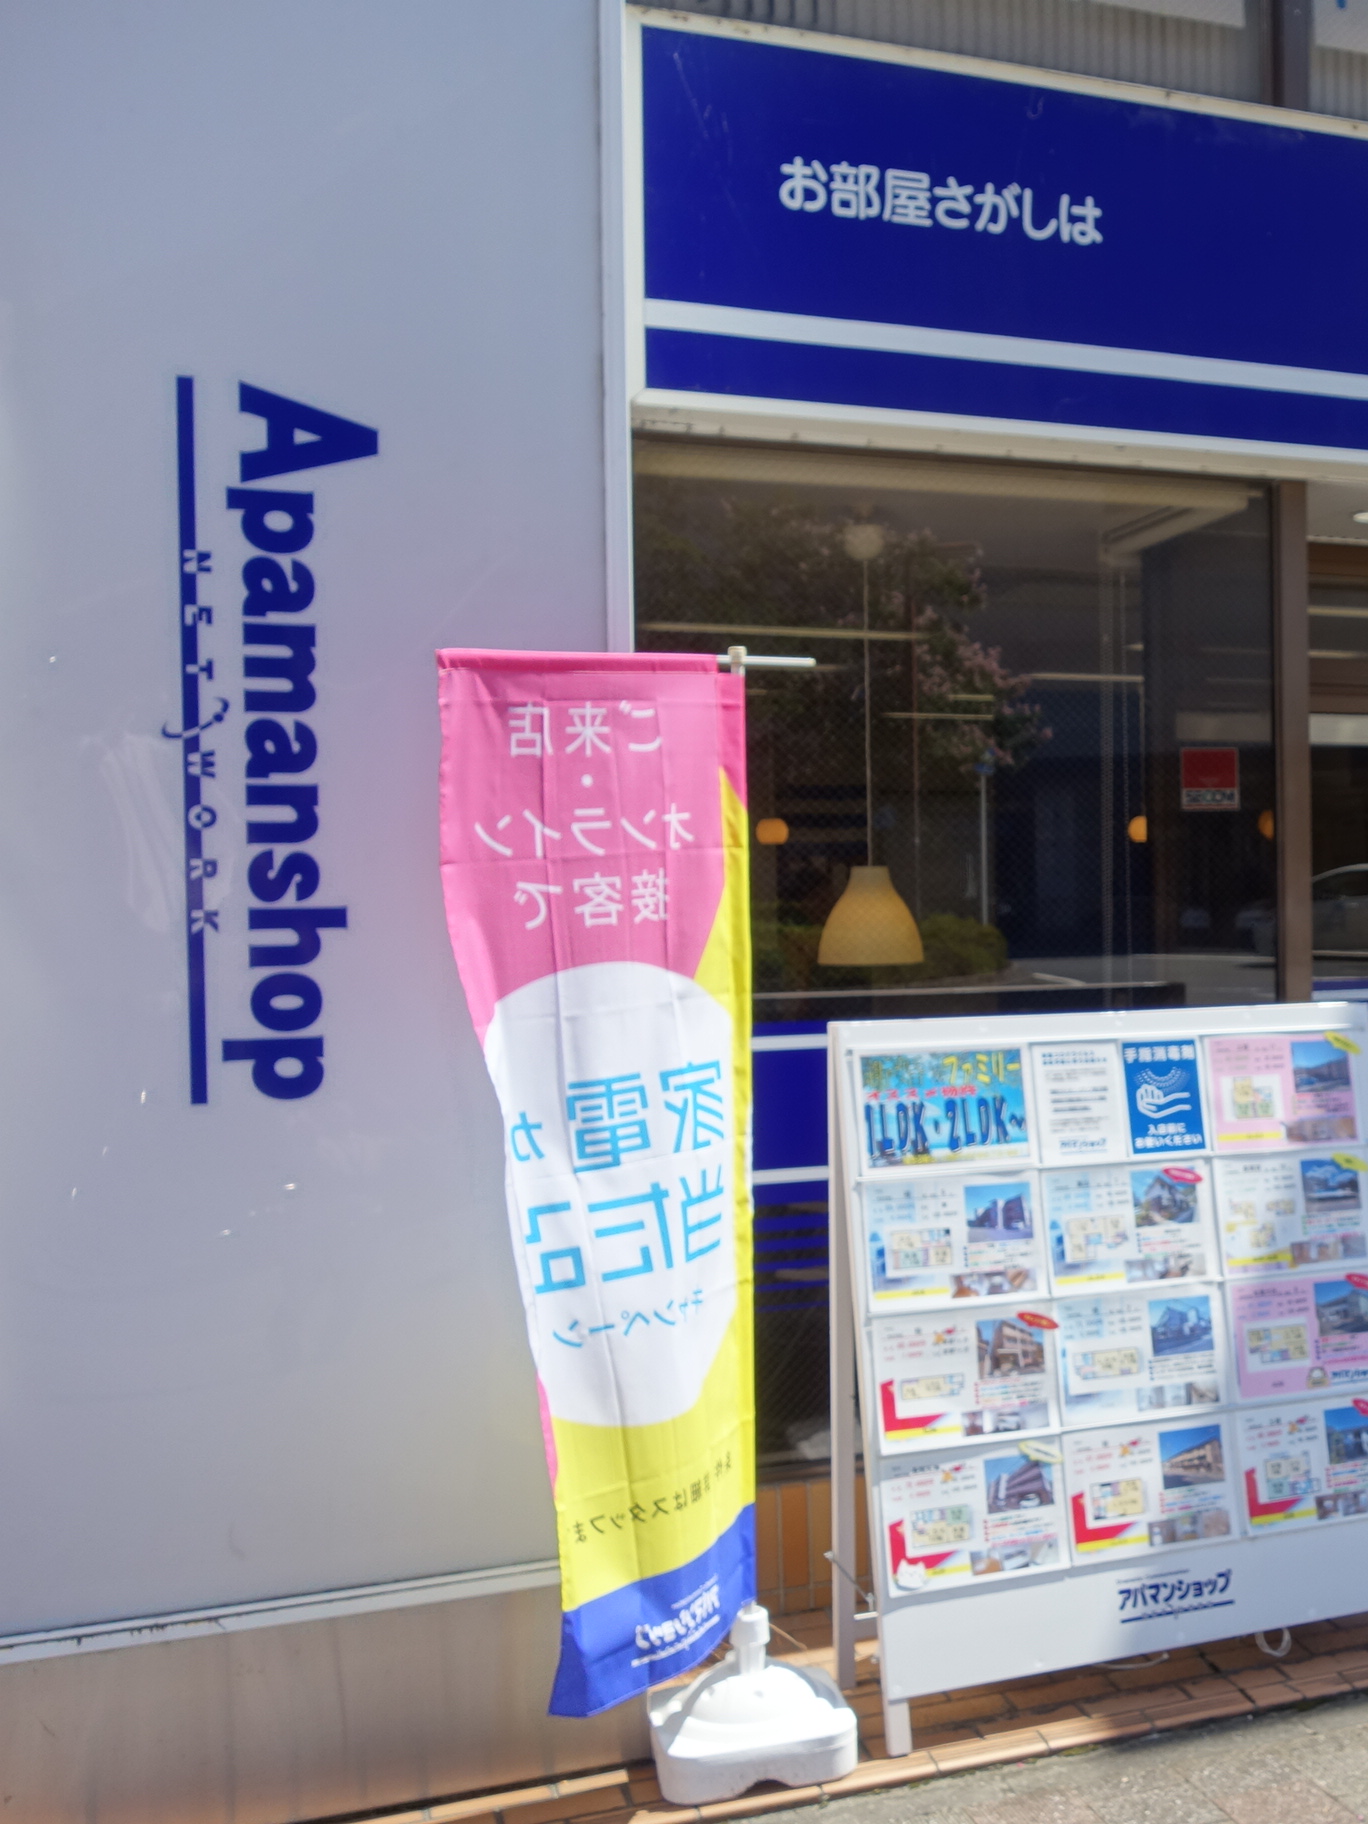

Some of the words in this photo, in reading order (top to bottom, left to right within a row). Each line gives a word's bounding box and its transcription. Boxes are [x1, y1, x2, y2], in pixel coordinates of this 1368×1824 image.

[778, 155, 1104, 246] お部屋さがしは
[221, 379, 380, 1102] Apamanshop
[1118, 1569, 1232, 1611] アパマンショップ
